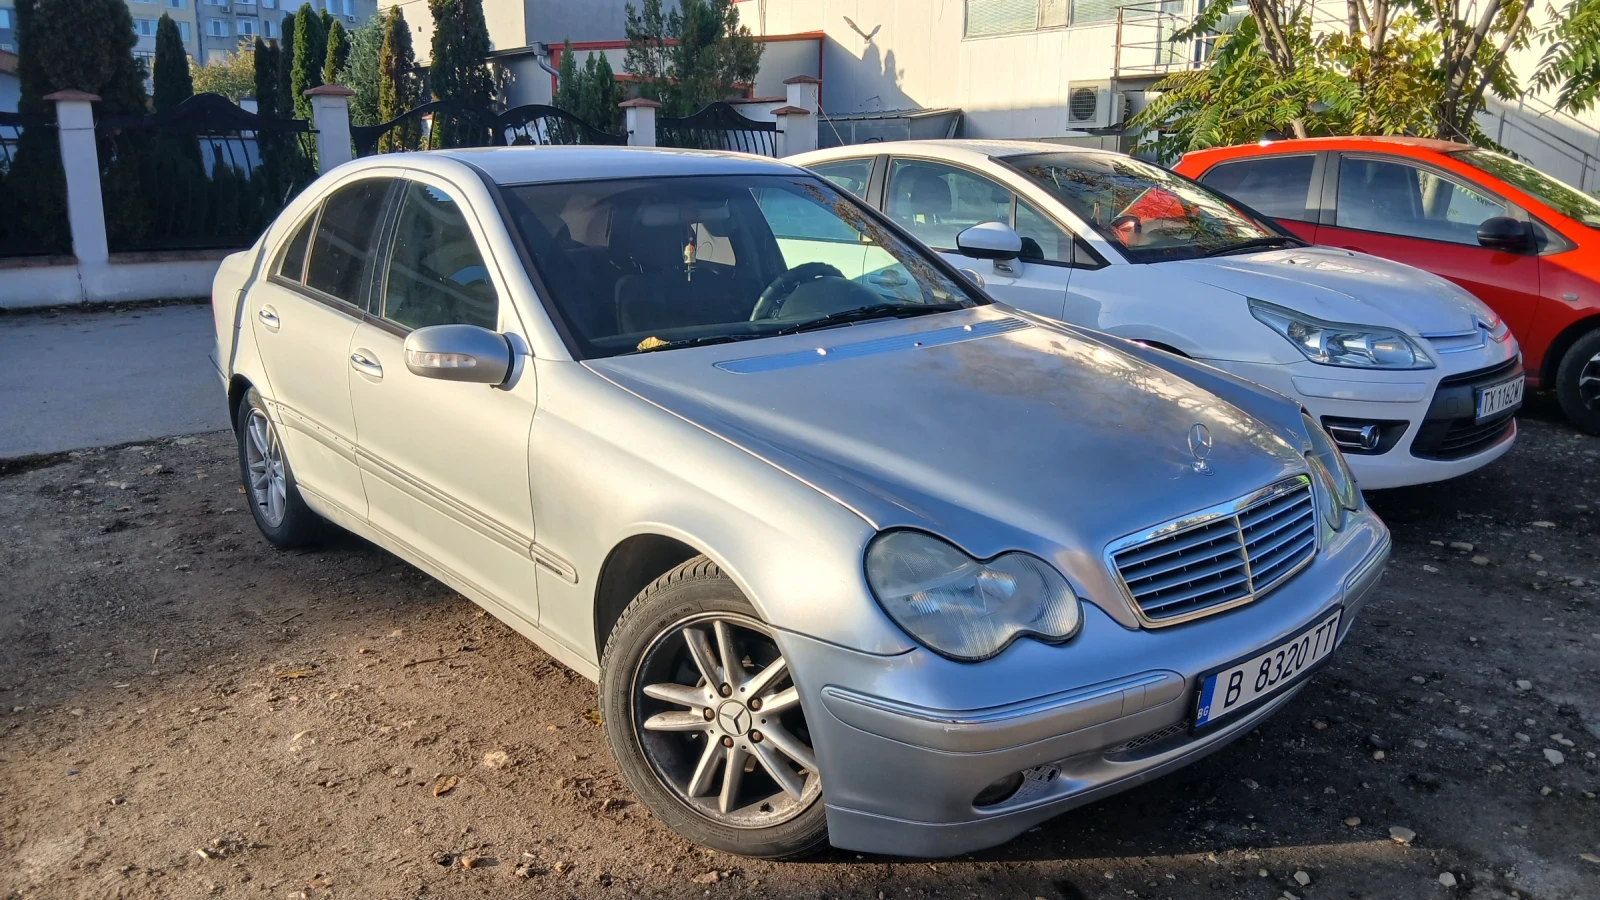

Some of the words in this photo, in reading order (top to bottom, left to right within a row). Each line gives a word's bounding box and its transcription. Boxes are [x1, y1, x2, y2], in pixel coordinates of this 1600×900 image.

[1484, 390, 1496, 413] TX
[1497, 384, 1515, 408] 1162
[1224, 670, 1243, 708] B
[1254, 636, 1310, 693] 8320
[1312, 617, 1338, 660] TT
[1197, 705, 1209, 720] BG
